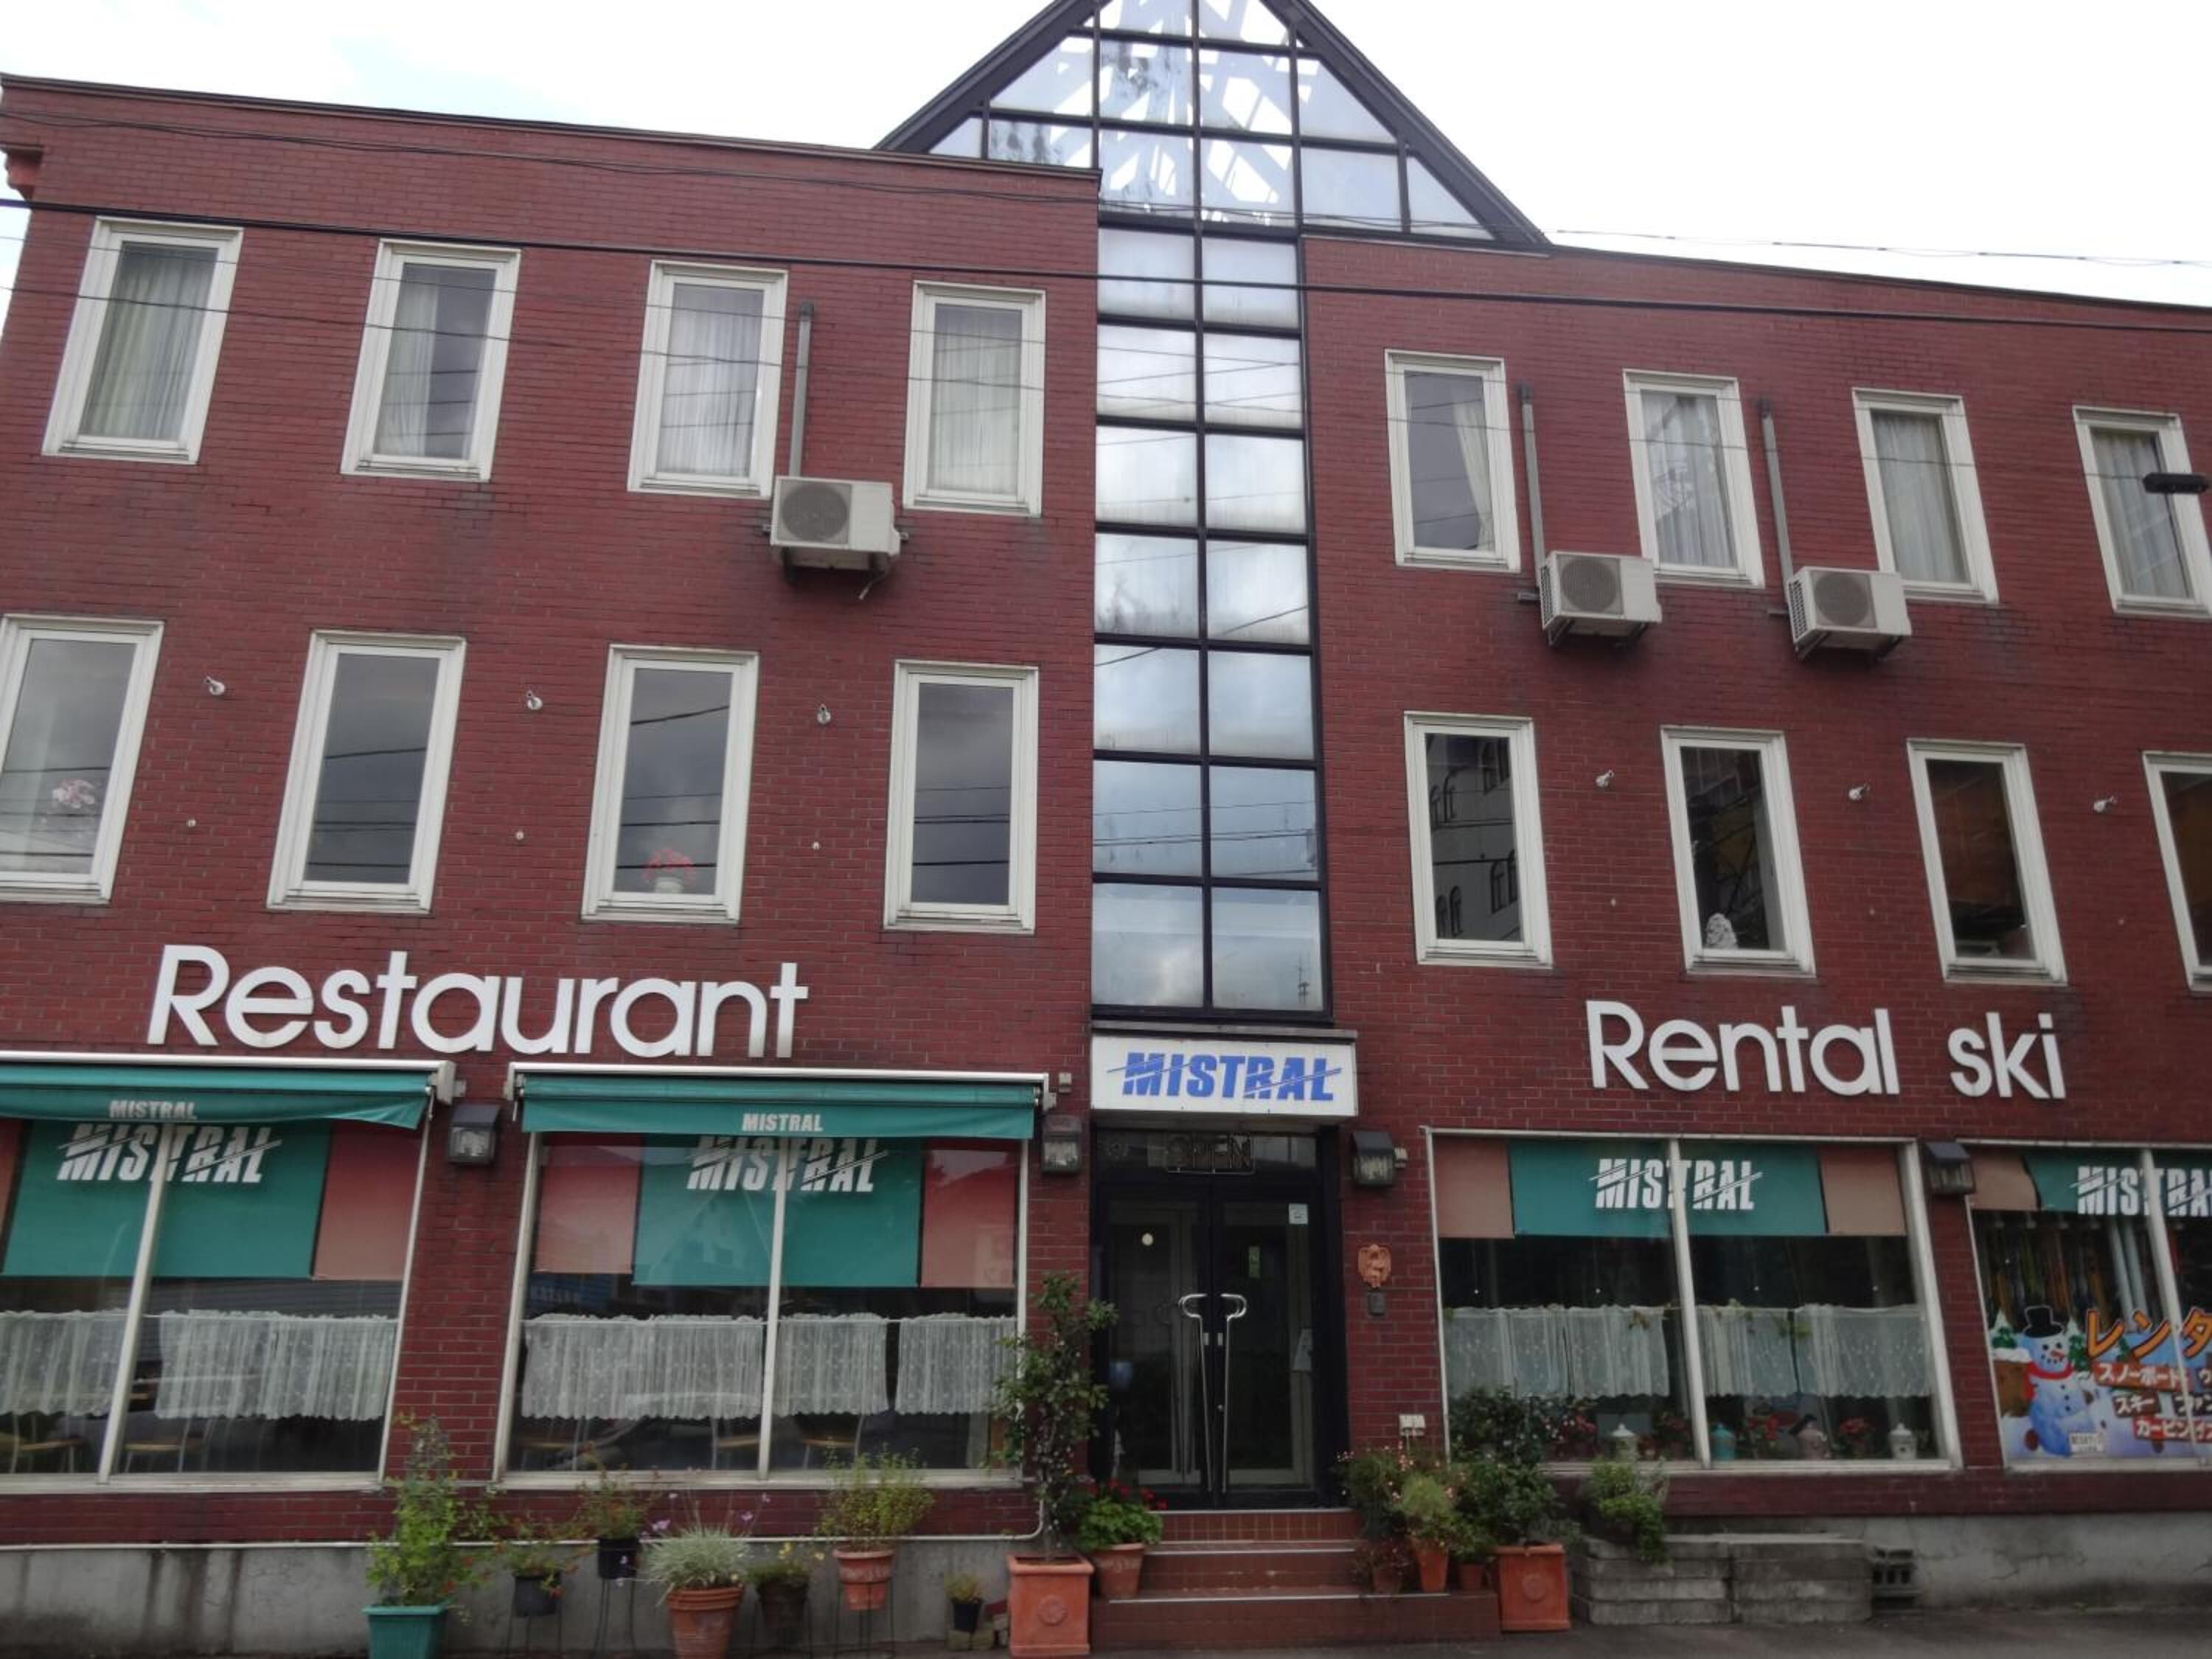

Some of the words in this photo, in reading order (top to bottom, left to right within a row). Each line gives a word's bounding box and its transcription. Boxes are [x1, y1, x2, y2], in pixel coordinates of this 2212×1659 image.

[147, 945, 809, 1058] Restaurant
[1585, 1000, 1900, 1096] Rental
[1947, 1012, 2066, 1099] ski
[1120, 1051, 1335, 1102] MISTRAL
[109, 1099, 198, 1120] MISTRAL
[741, 1113, 824, 1133] MISTRAL
[57, 1123, 274, 1183] MISTRAL
[686, 1136, 879, 1192] MISTRAL
[1167, 1134, 1251, 1169] OPEN
[1594, 1158, 1756, 1210] MISTRAL
[2076, 1166, 2212, 1217] MISRA
